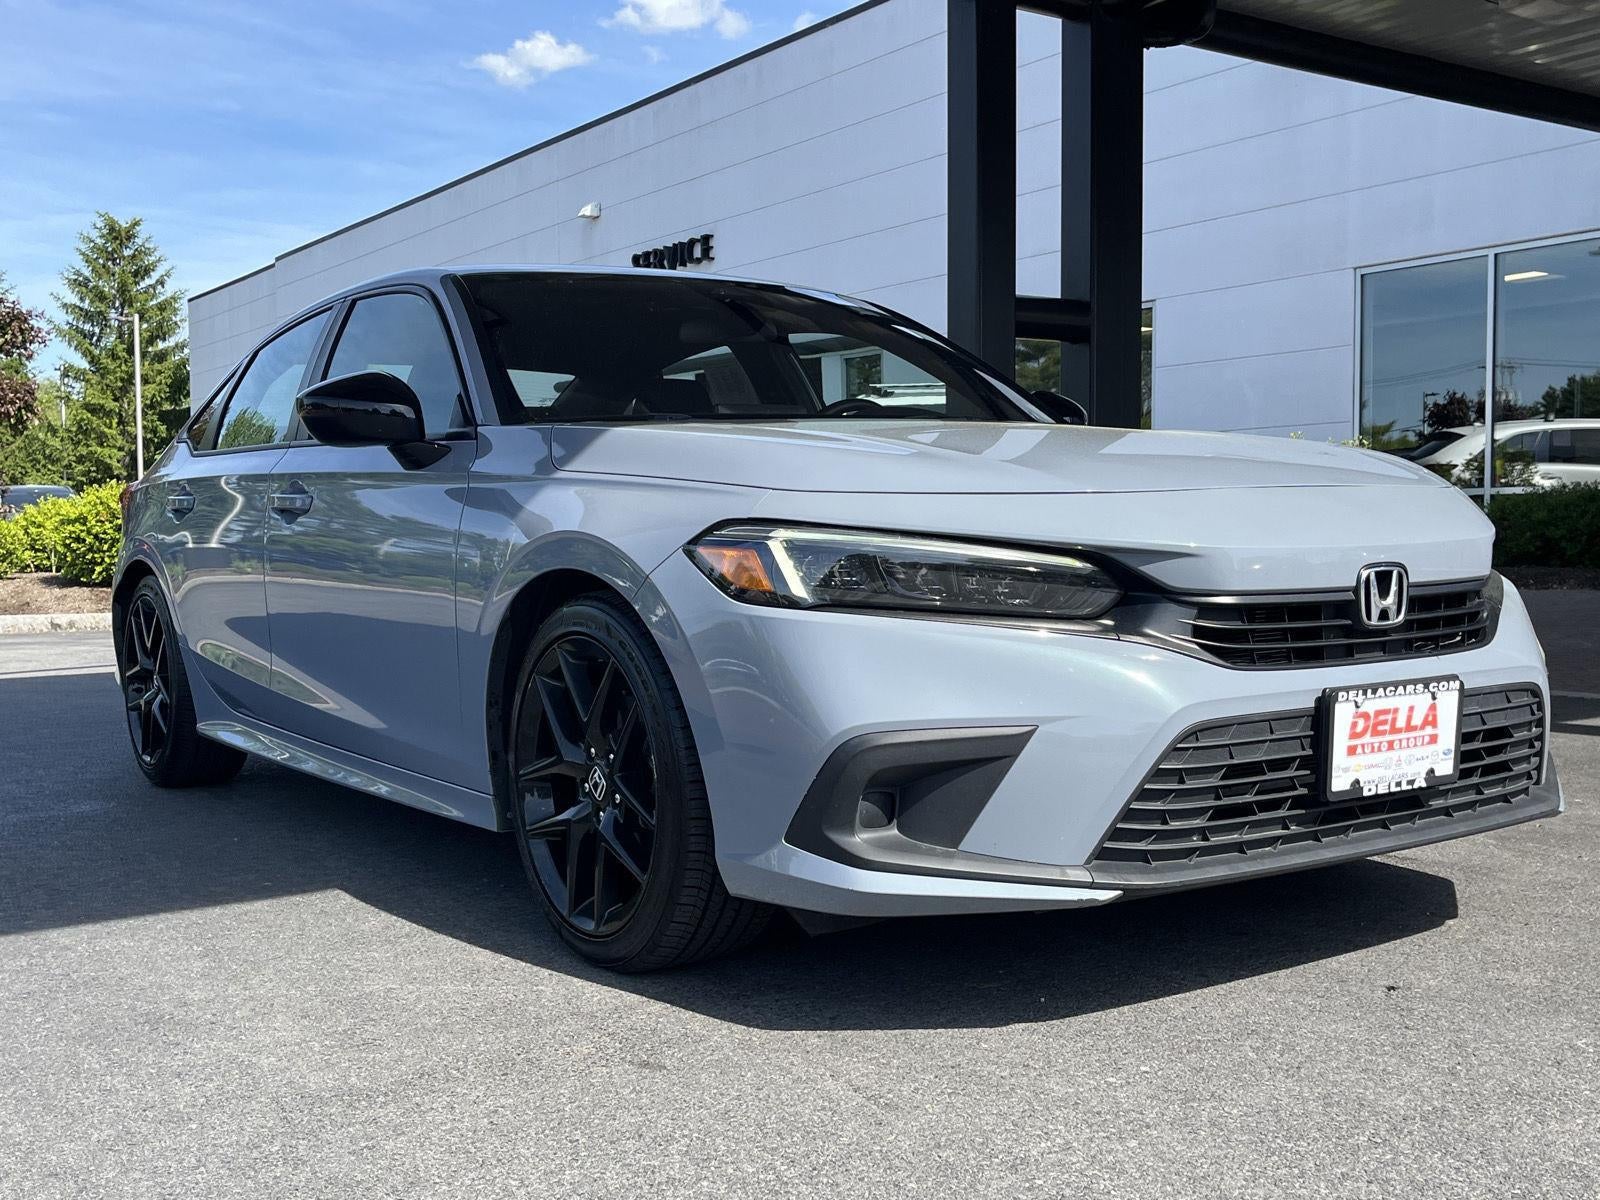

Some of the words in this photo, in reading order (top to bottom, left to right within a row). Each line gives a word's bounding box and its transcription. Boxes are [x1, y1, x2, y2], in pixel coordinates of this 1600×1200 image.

[631, 233, 715, 270] SERVICE
[1337, 680, 1460, 702] DELLACARS.COM
[1347, 703, 1439, 741] DELLA
[1355, 742, 1388, 755] AUTO
[1393, 735, 1431, 750] GROUP
[1362, 777, 1427, 797] DELLA
